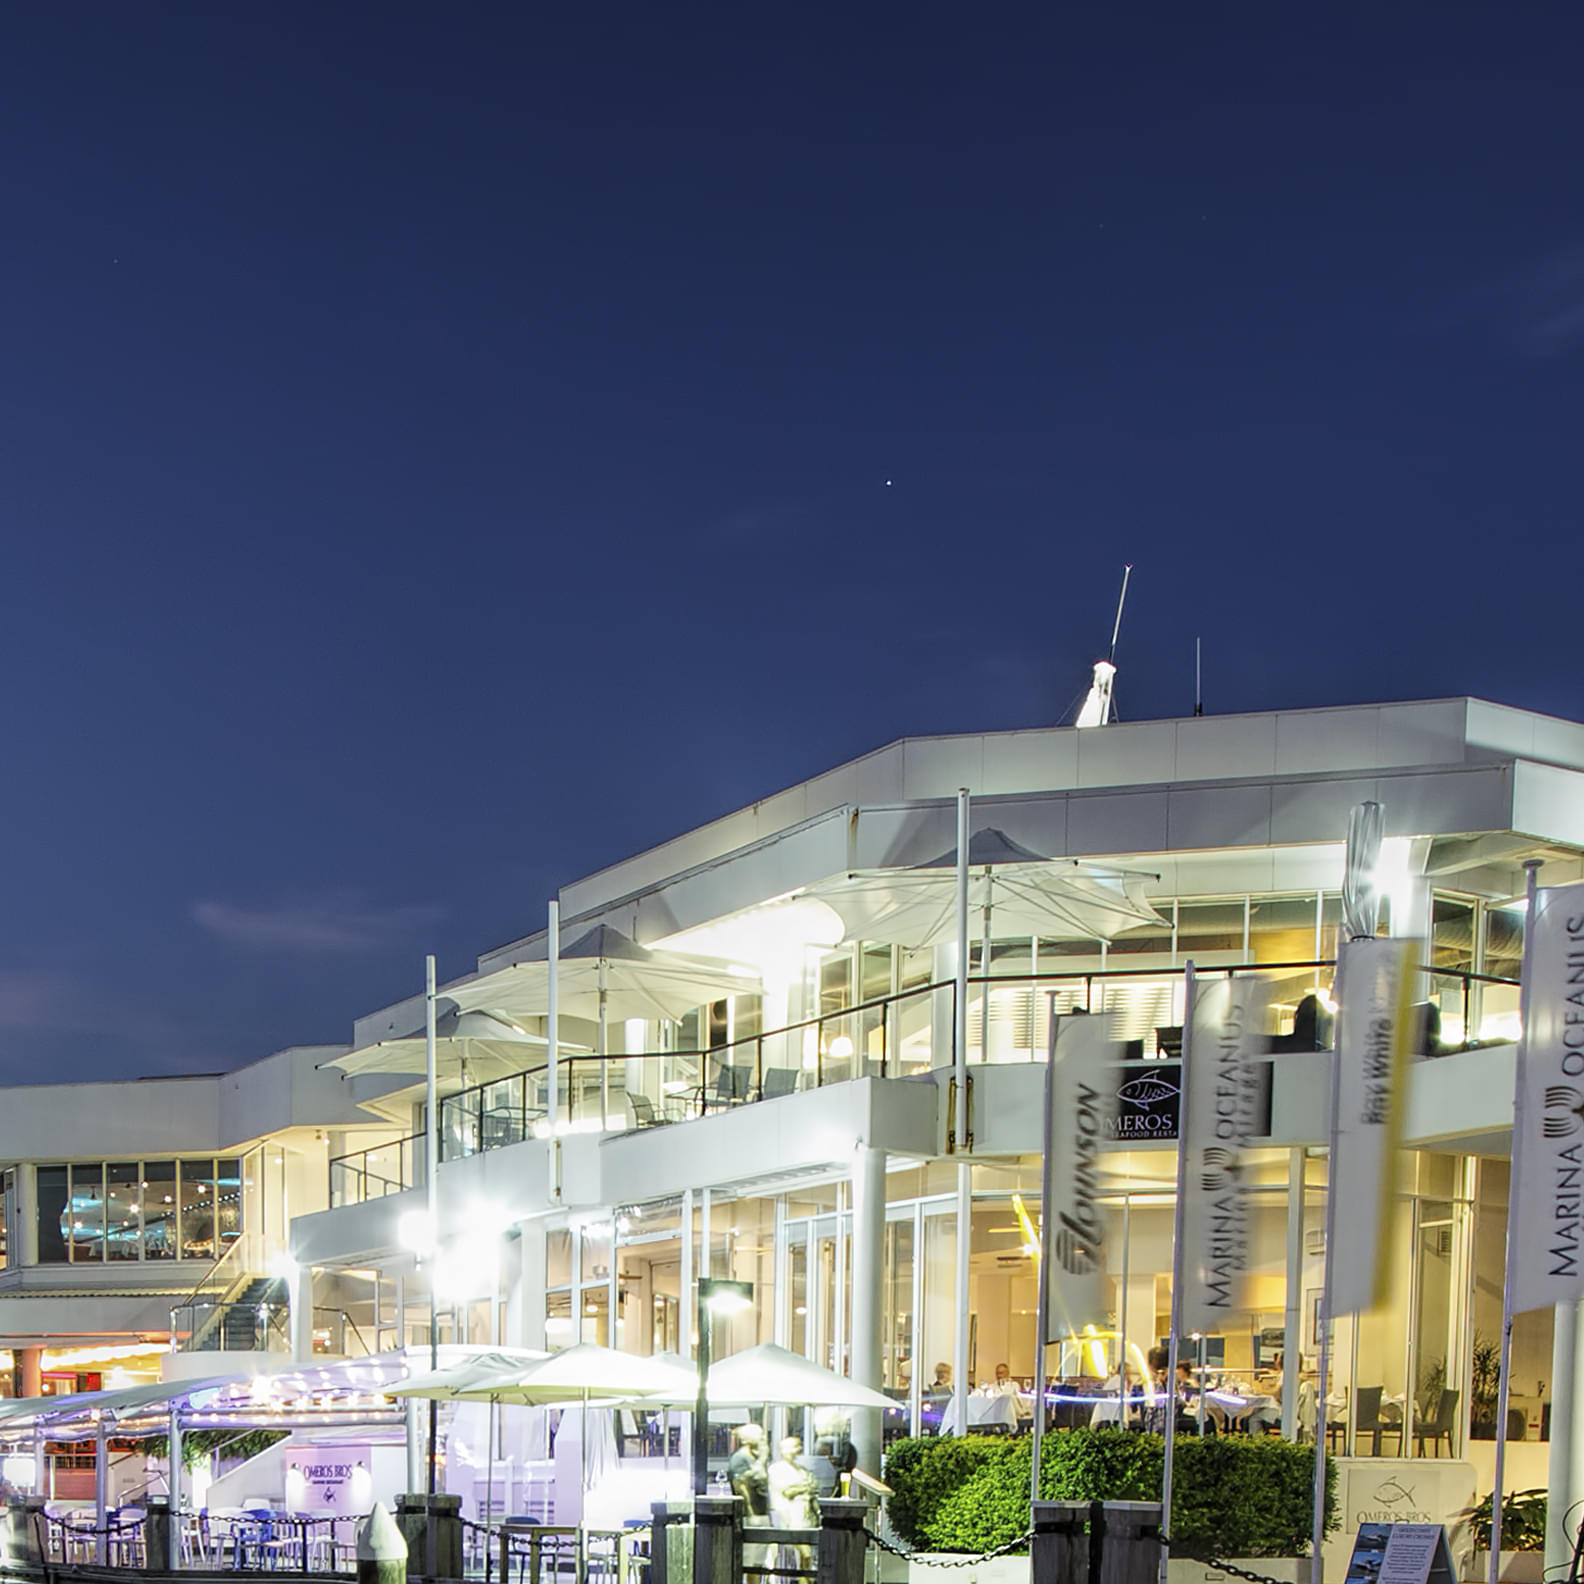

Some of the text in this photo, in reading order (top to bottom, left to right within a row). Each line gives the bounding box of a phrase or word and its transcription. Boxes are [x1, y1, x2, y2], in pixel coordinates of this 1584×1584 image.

[1105, 1113, 1173, 1131] MEROS
[1206, 1004, 1245, 1308] MARINA OCEANUS
[1548, 1142, 1582, 1278] MARINA
